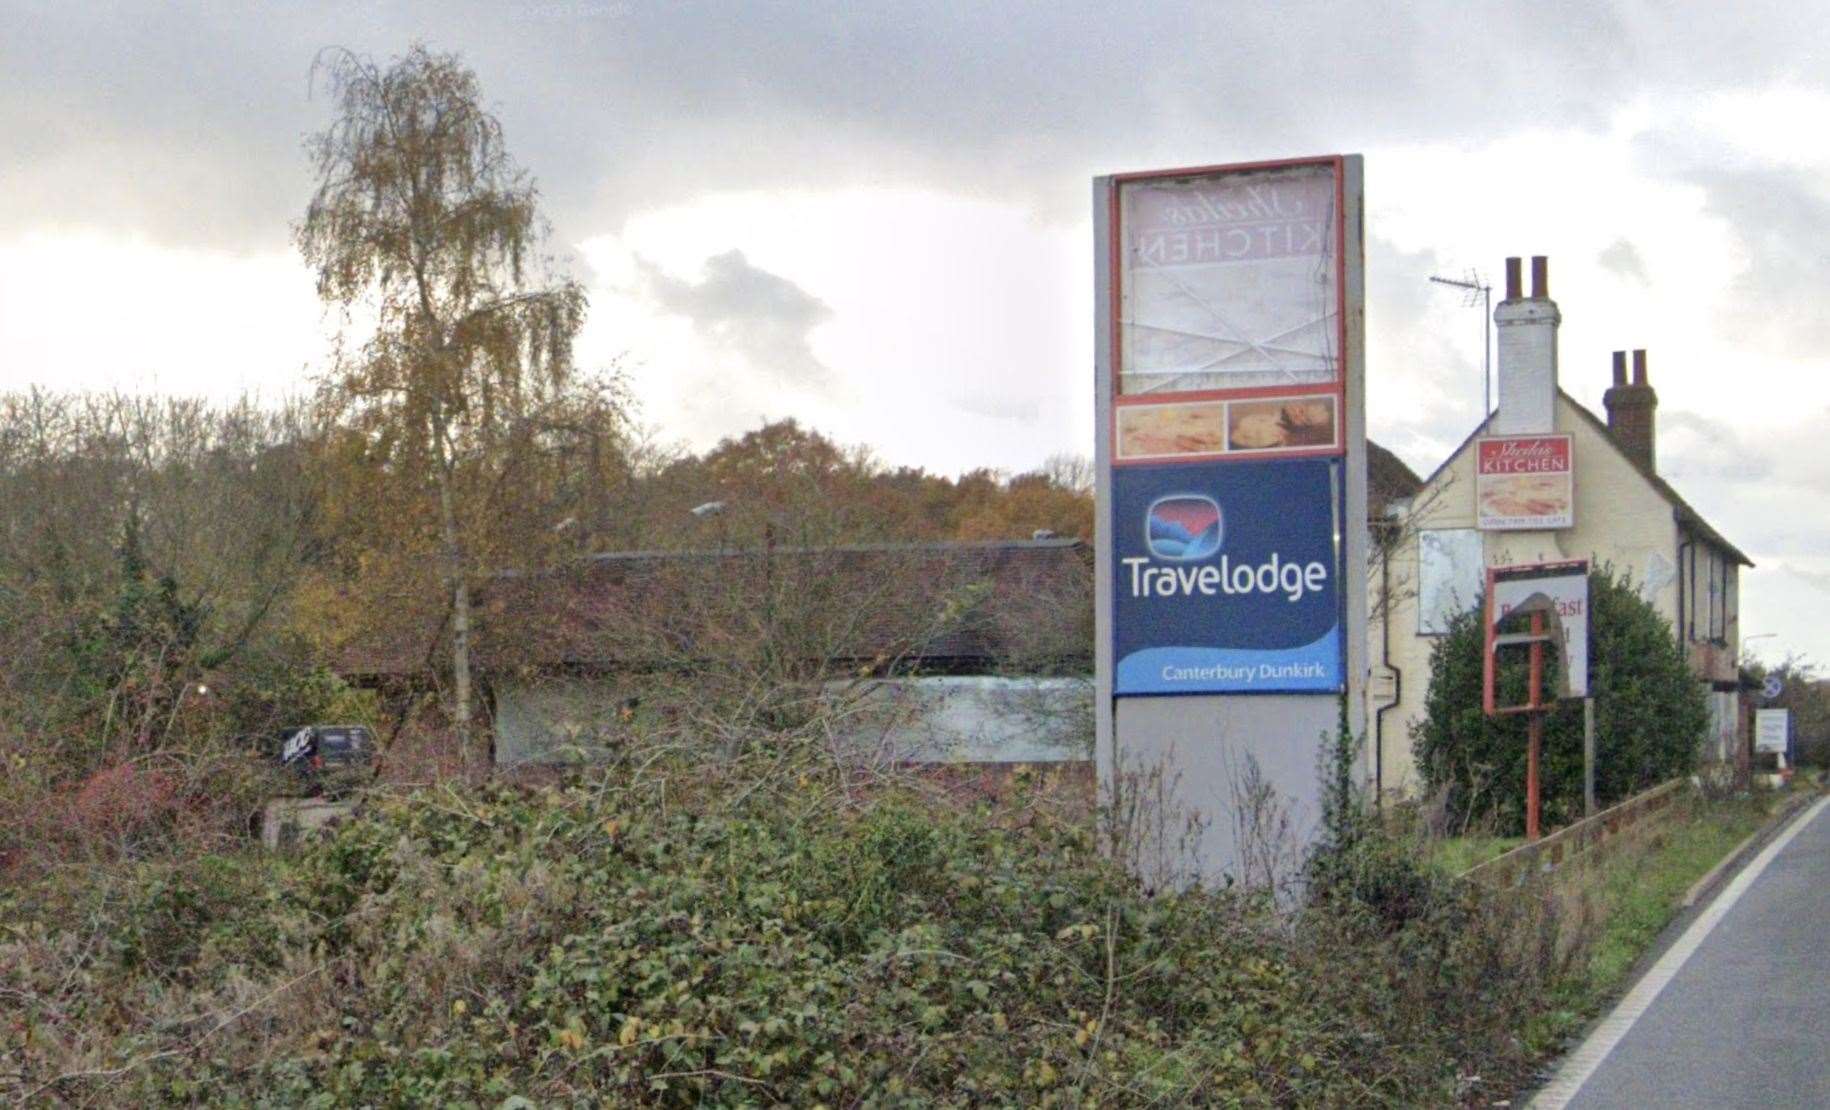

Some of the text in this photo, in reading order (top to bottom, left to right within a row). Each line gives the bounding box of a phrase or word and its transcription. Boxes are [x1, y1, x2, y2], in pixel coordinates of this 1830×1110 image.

[1484, 458, 1564, 473] KITCHEN
[1122, 553, 1327, 602] Travelodge
[1163, 662, 1325, 682] Canterbury Dunkirk
